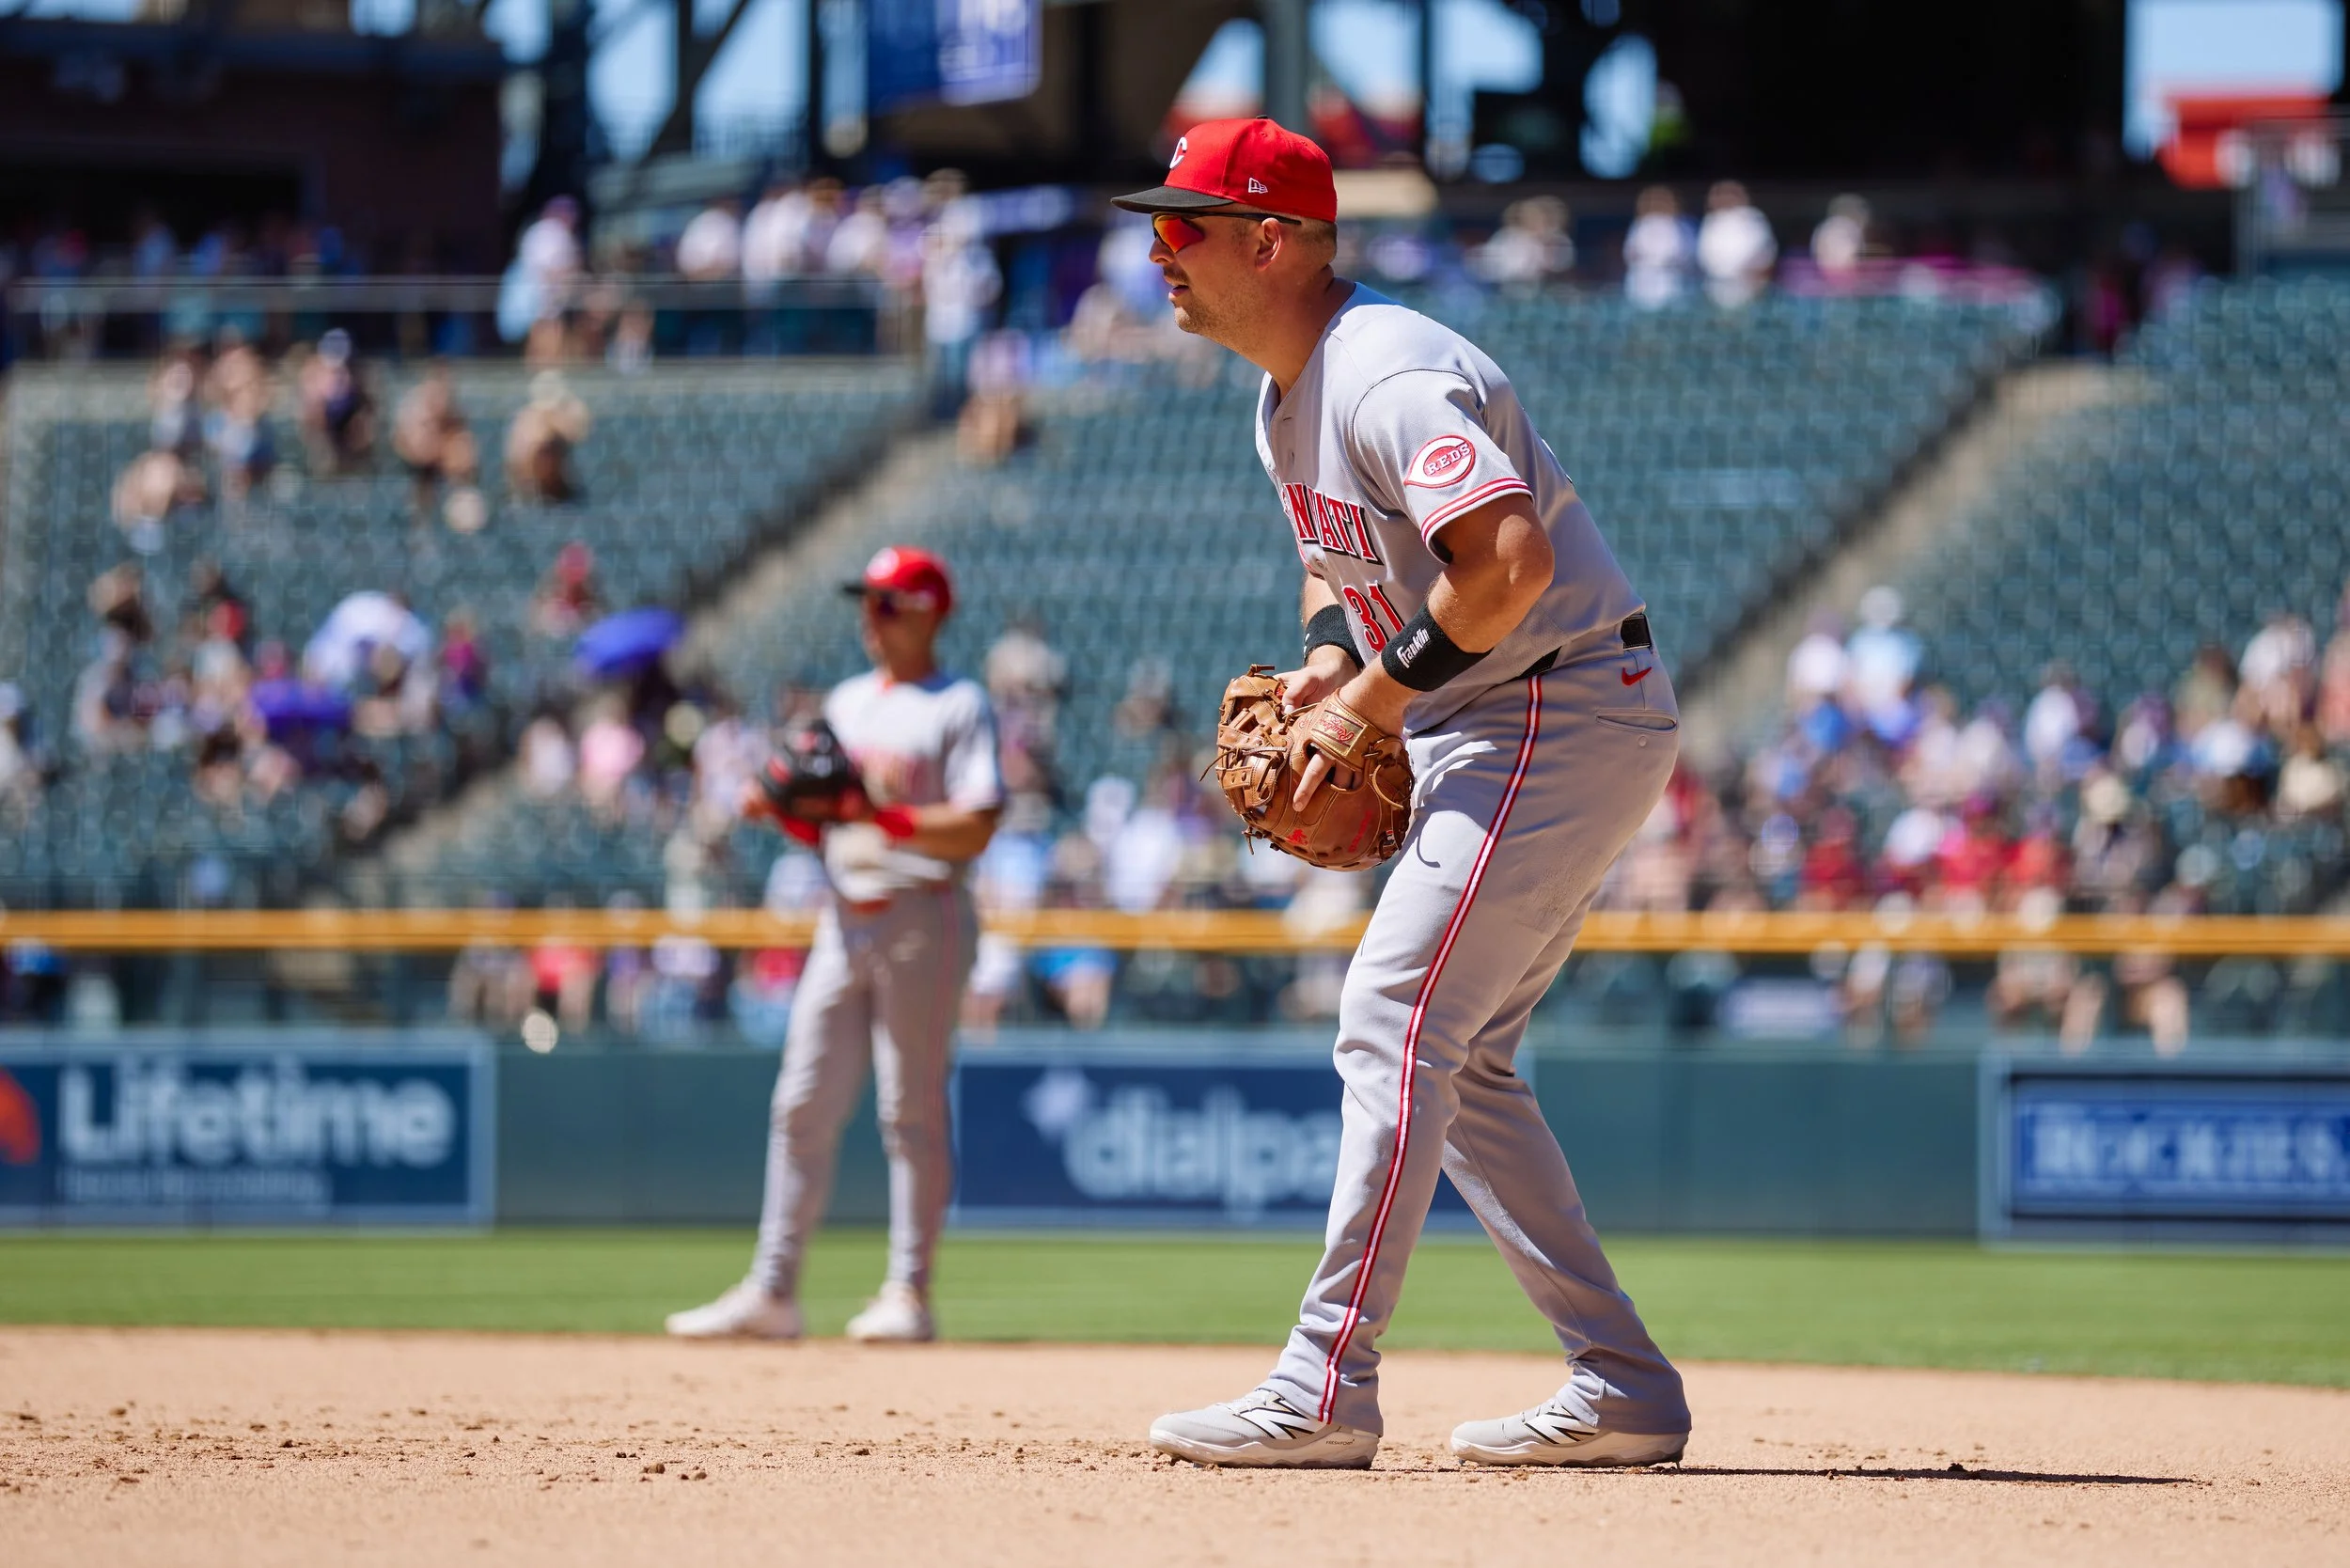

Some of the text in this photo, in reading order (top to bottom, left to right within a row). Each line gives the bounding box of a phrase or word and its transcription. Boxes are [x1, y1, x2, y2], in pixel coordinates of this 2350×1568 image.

[1425, 443, 1472, 476] REDS
[1341, 580, 1405, 654] 31
[1396, 628, 1431, 668] Franklin
[58, 1055, 457, 1168] Lifetime
[1062, 1081, 1342, 1220] dialpa
